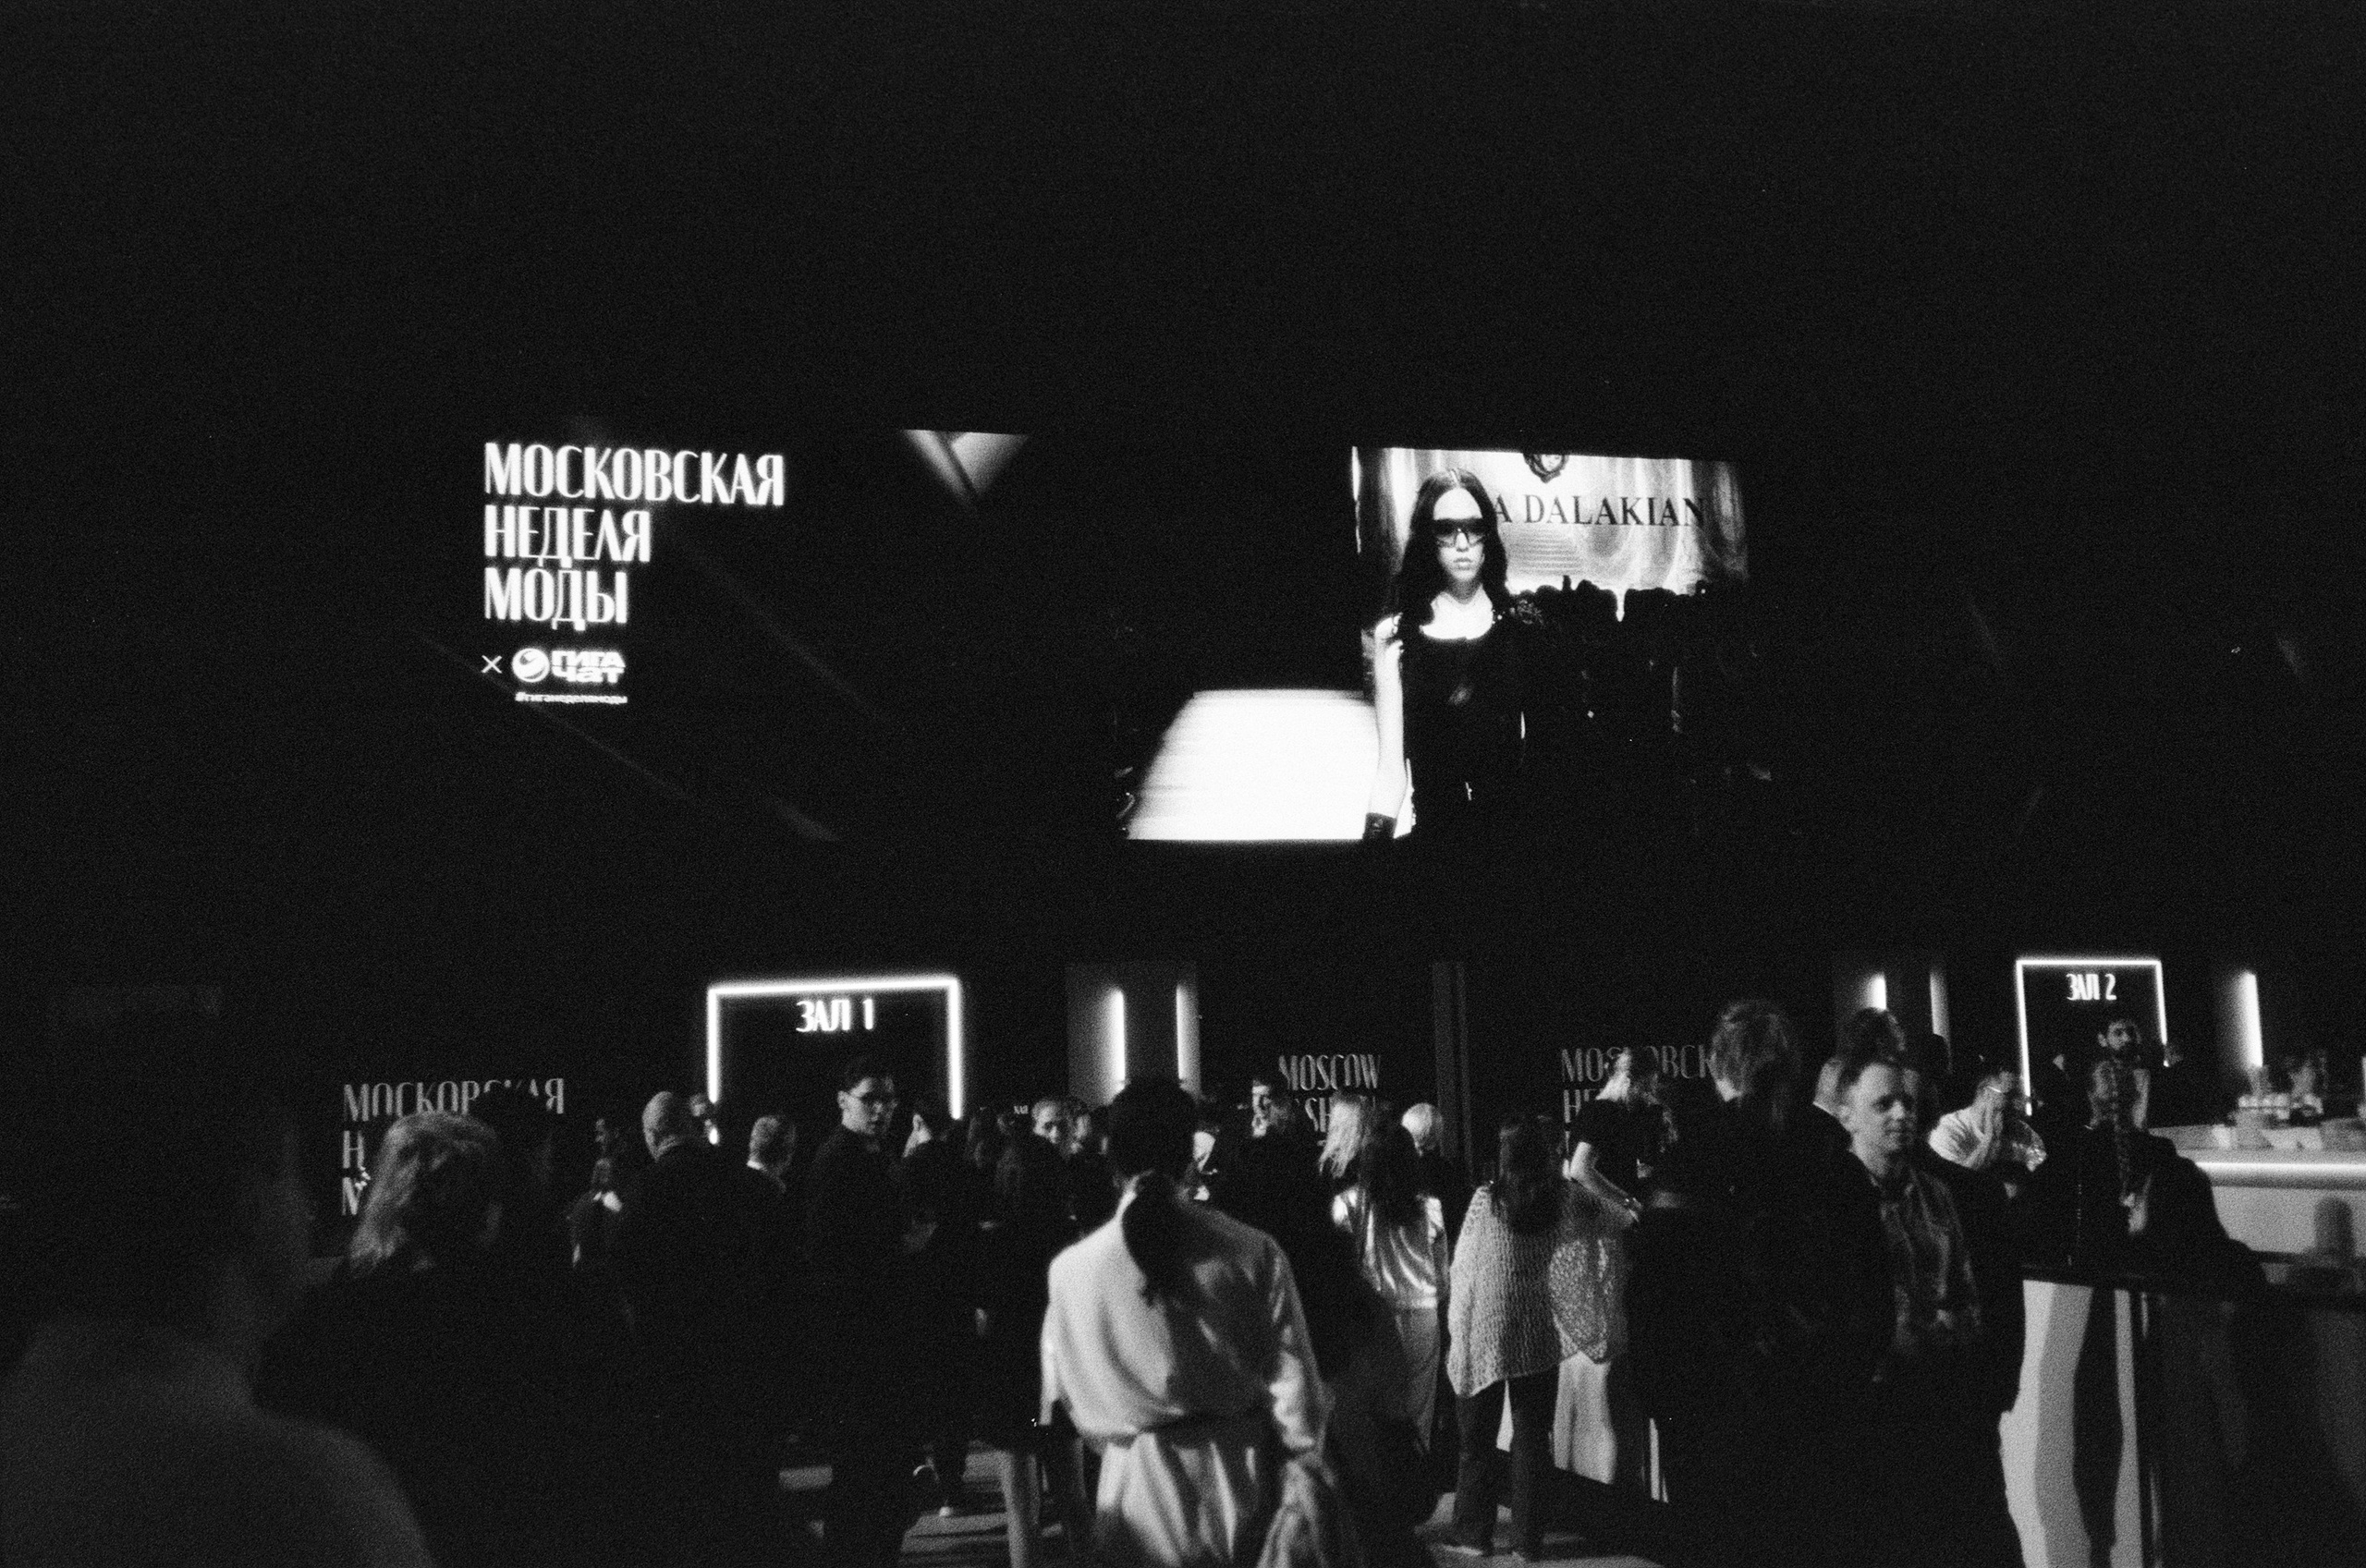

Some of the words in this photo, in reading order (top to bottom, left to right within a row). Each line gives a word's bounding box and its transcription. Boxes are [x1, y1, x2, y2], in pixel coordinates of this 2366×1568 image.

[484, 442, 785, 506] МОСКОВСКАЯ
[1524, 493, 1704, 528] DALAKIAN
[484, 504, 652, 567] НЕДЕЛЯ
[484, 566, 628, 631] МОДЫ
[552, 650, 626, 667] ГИГА
[2066, 973, 2100, 1001] ЗАЛ
[2104, 973, 2117, 1001] 2
[796, 999, 850, 1032] ЗАЛ
[862, 998, 873, 1030] 1
[1277, 1054, 1381, 1091] MOSCOW
